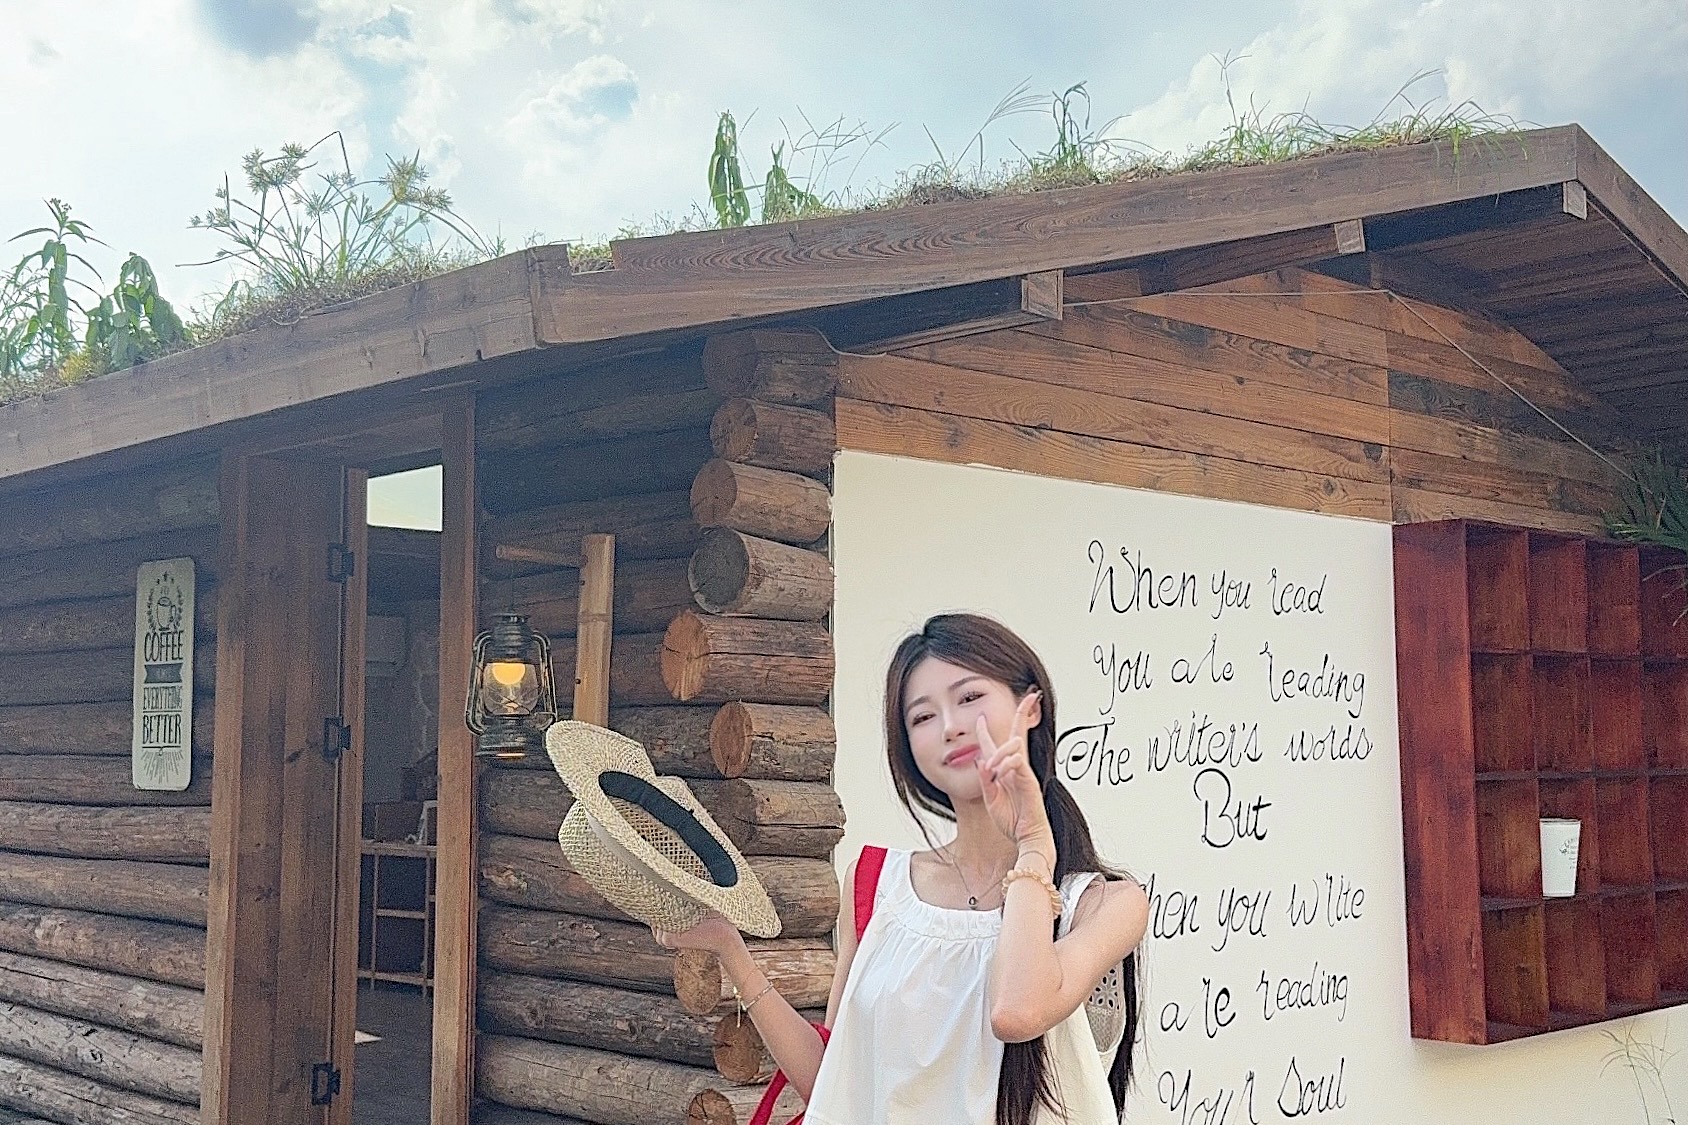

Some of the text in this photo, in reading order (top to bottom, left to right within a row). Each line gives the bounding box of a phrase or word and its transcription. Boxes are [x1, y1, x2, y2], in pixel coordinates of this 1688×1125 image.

[1087, 539, 1327, 620] When you read
[143, 630, 184, 662] COFFEE
[1171, 633, 1235, 684] are
[1258, 640, 1366, 719] reading
[142, 685, 183, 710] EVERYTHING
[142, 713, 182, 745] BETTER
[1056, 710, 1374, 786] The writer's words
[1193, 767, 1273, 849] But
[1139, 872, 1200, 940] hen
[1210, 886, 1272, 953] you
[1255, 960, 1349, 1023] reading
[1277, 1056, 1347, 1118] Soul
